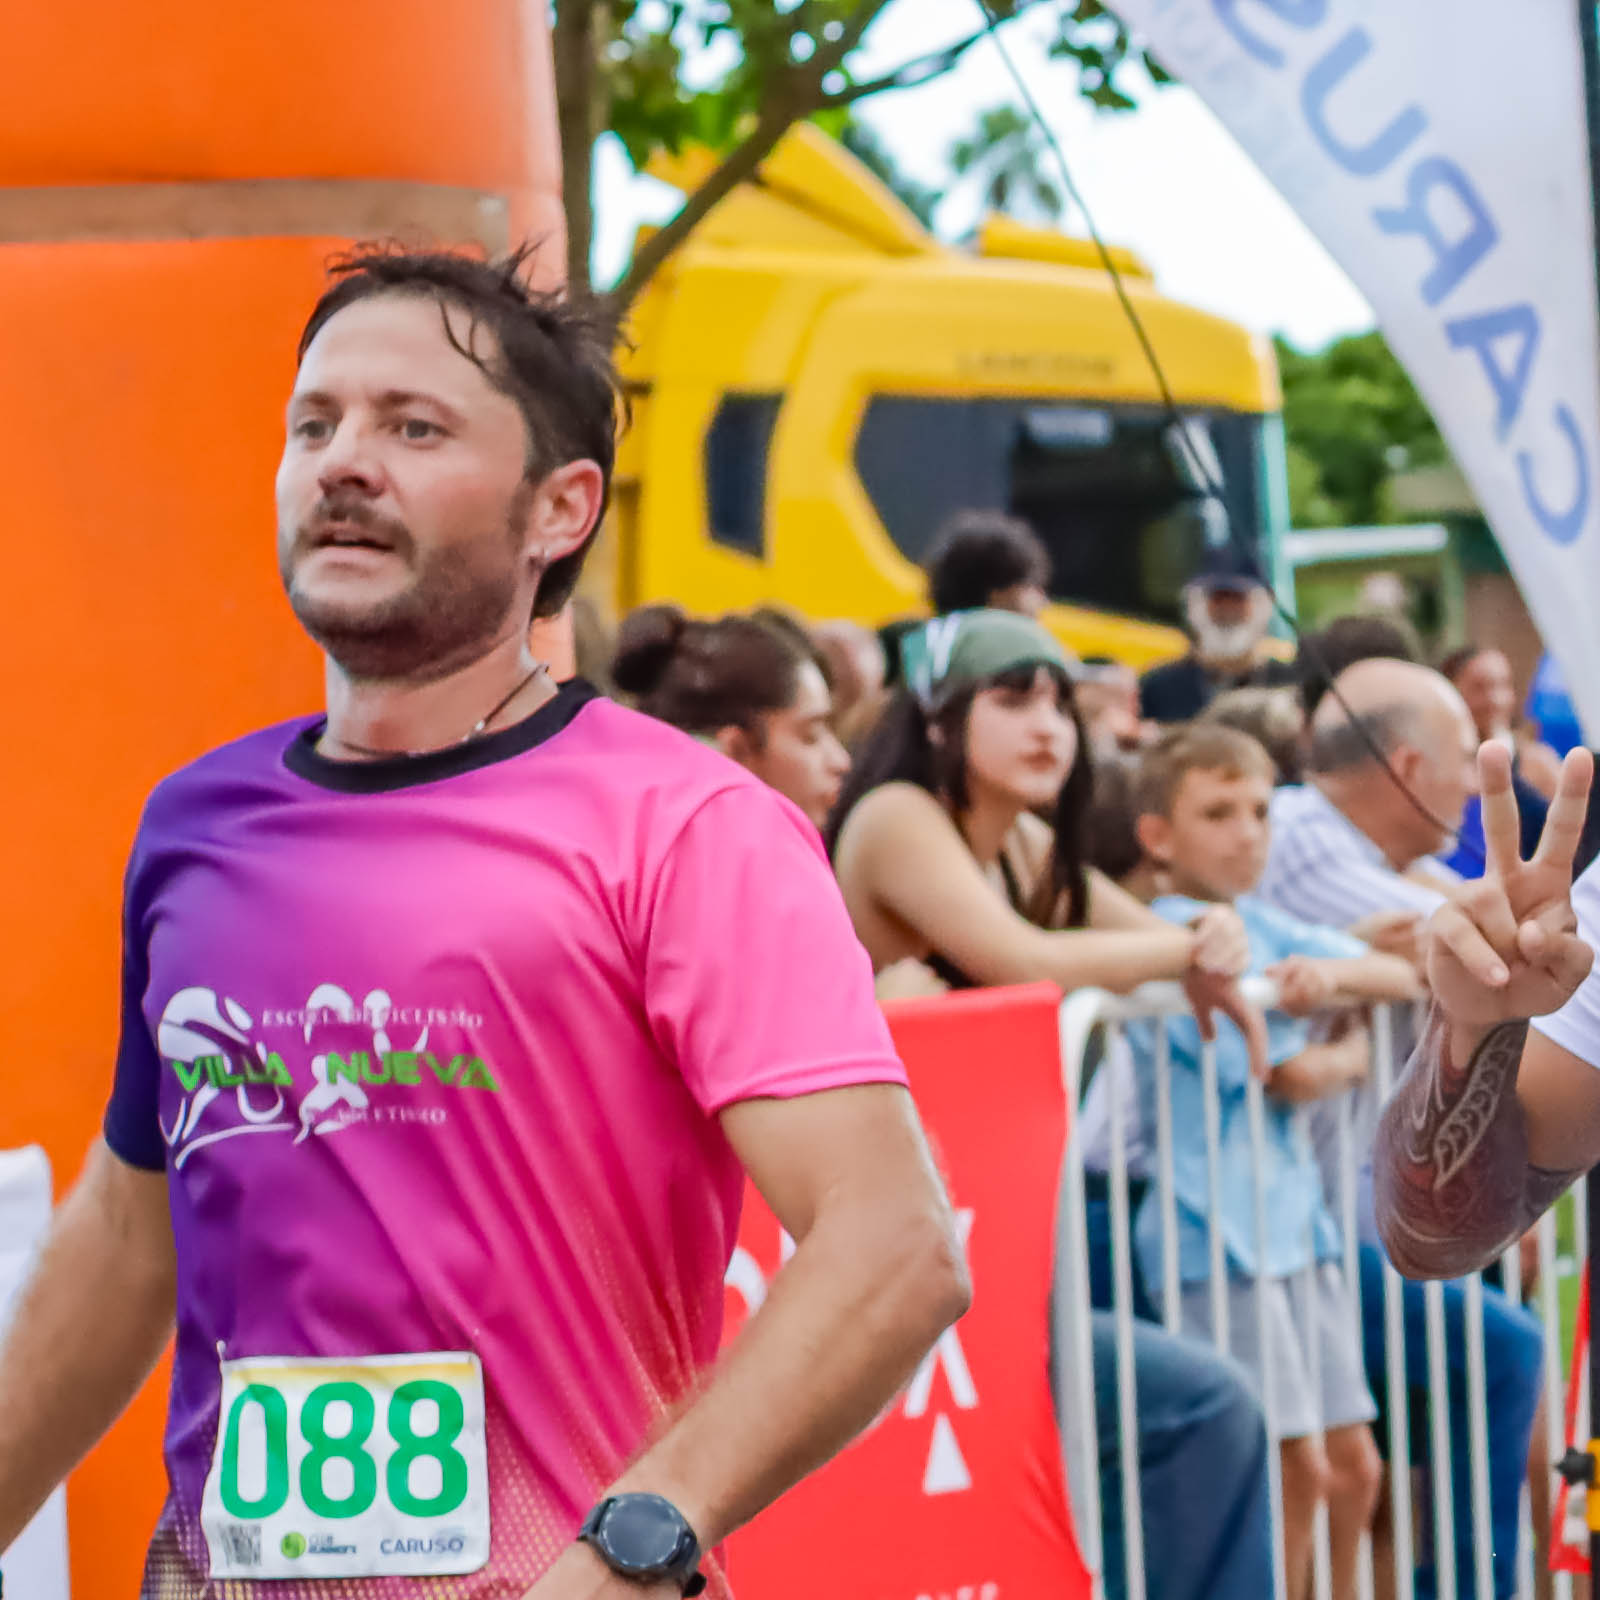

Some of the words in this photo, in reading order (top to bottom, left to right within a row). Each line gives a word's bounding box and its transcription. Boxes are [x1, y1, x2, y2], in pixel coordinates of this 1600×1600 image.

[172, 1051, 294, 1092] VILLA
[326, 1051, 501, 1092] NUEVA
[220, 1380, 468, 1519] 088
[380, 1537, 465, 1555] CARUSO
